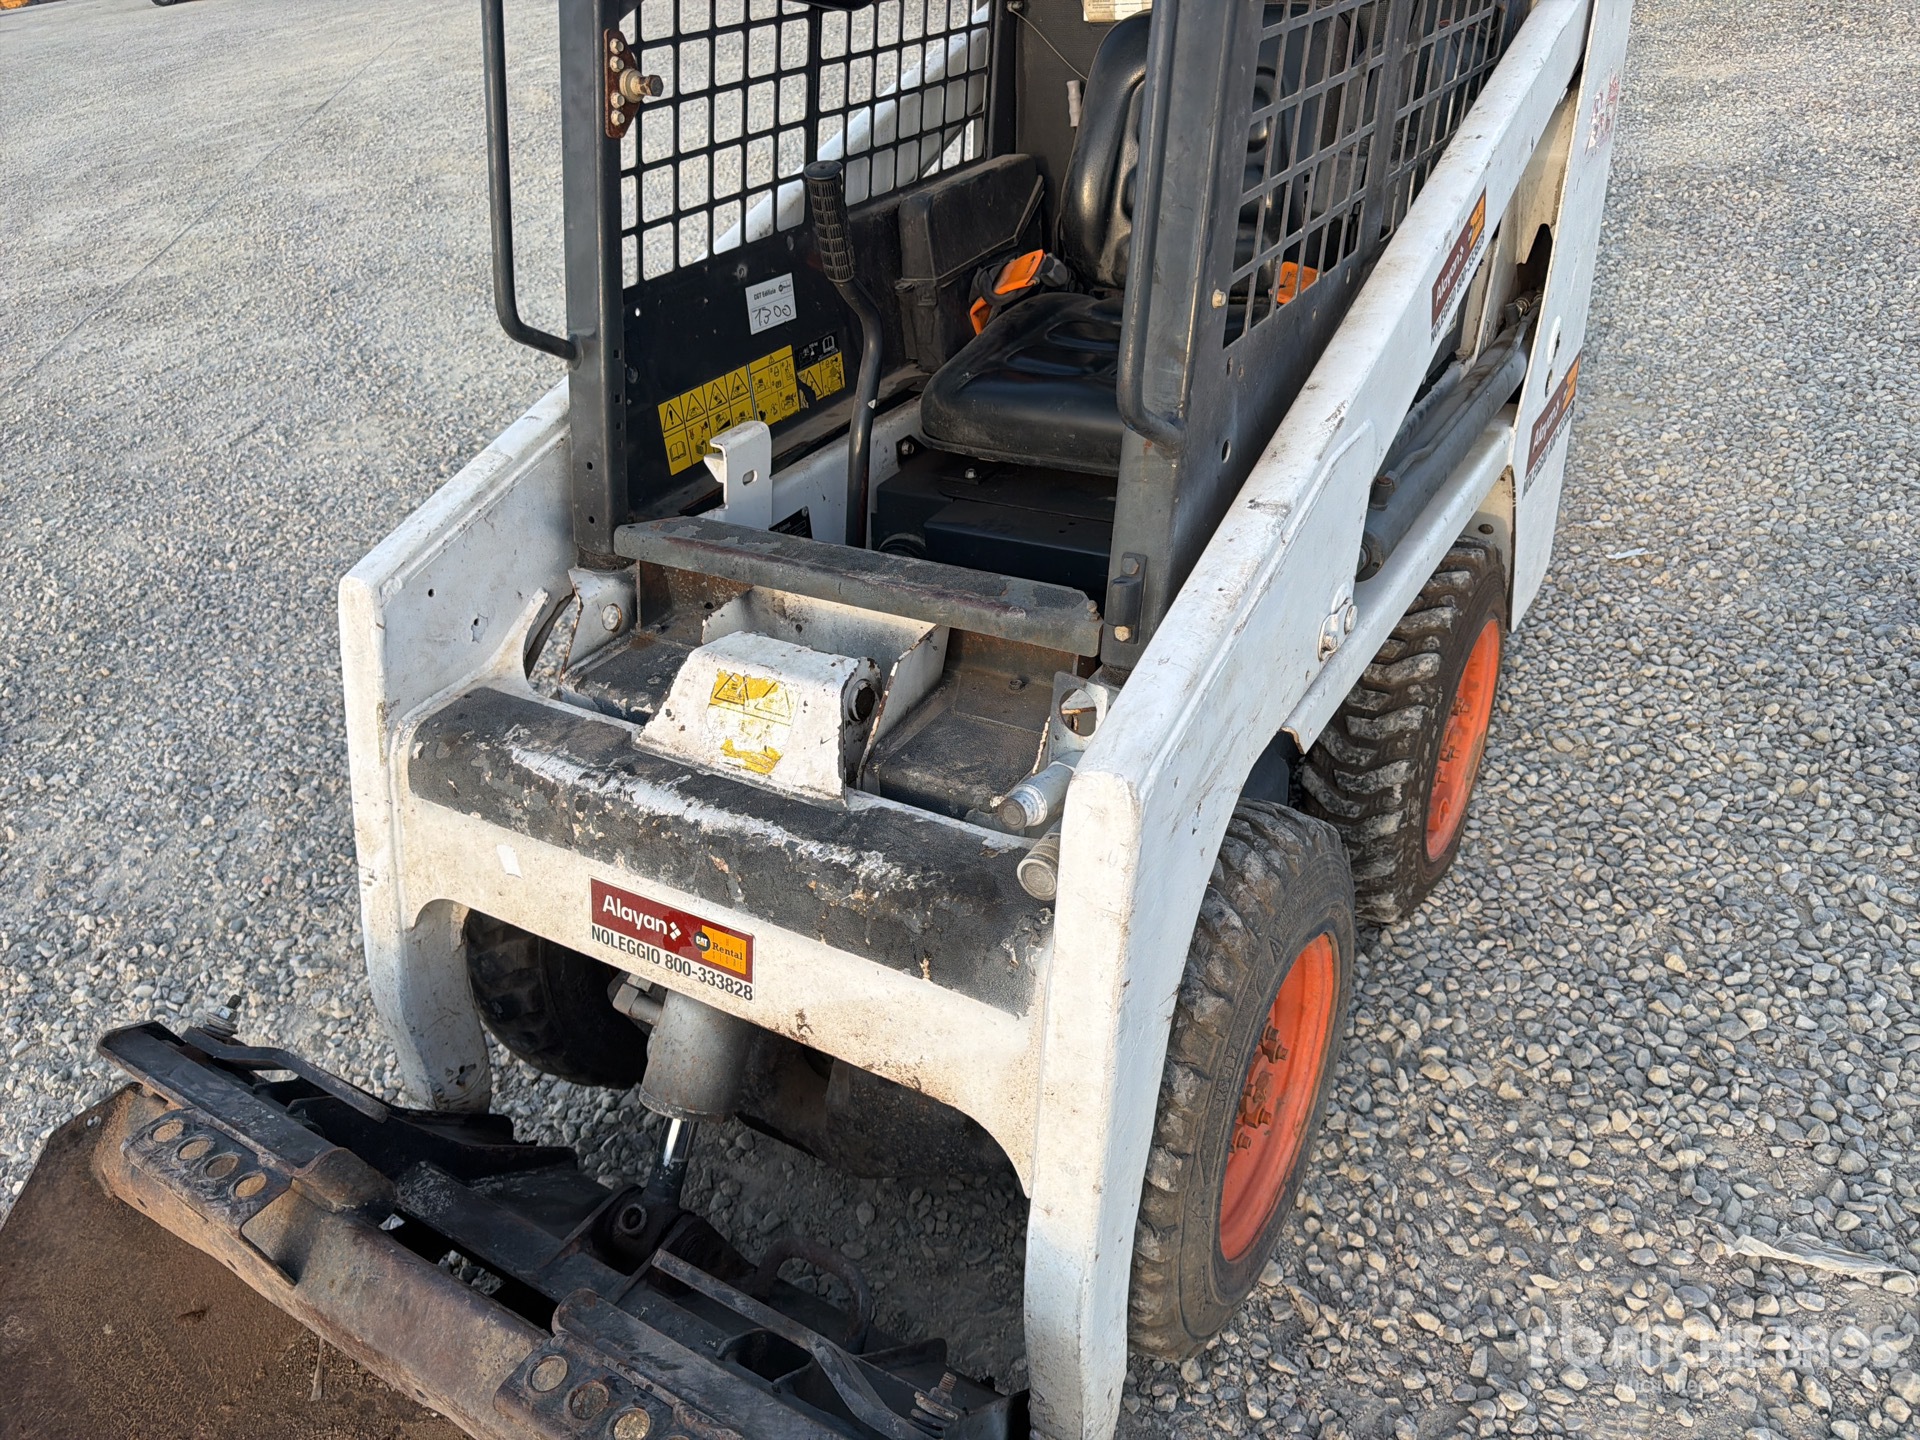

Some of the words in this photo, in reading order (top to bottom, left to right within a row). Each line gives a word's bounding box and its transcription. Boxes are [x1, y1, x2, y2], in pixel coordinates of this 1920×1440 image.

[602, 894, 668, 936] Alayan
[591, 925, 660, 965] NOLEGGIO
[665, 954, 753, 1001] 800-333828
[695, 935, 708, 947] CAT
[712, 942, 743, 960] Rental
